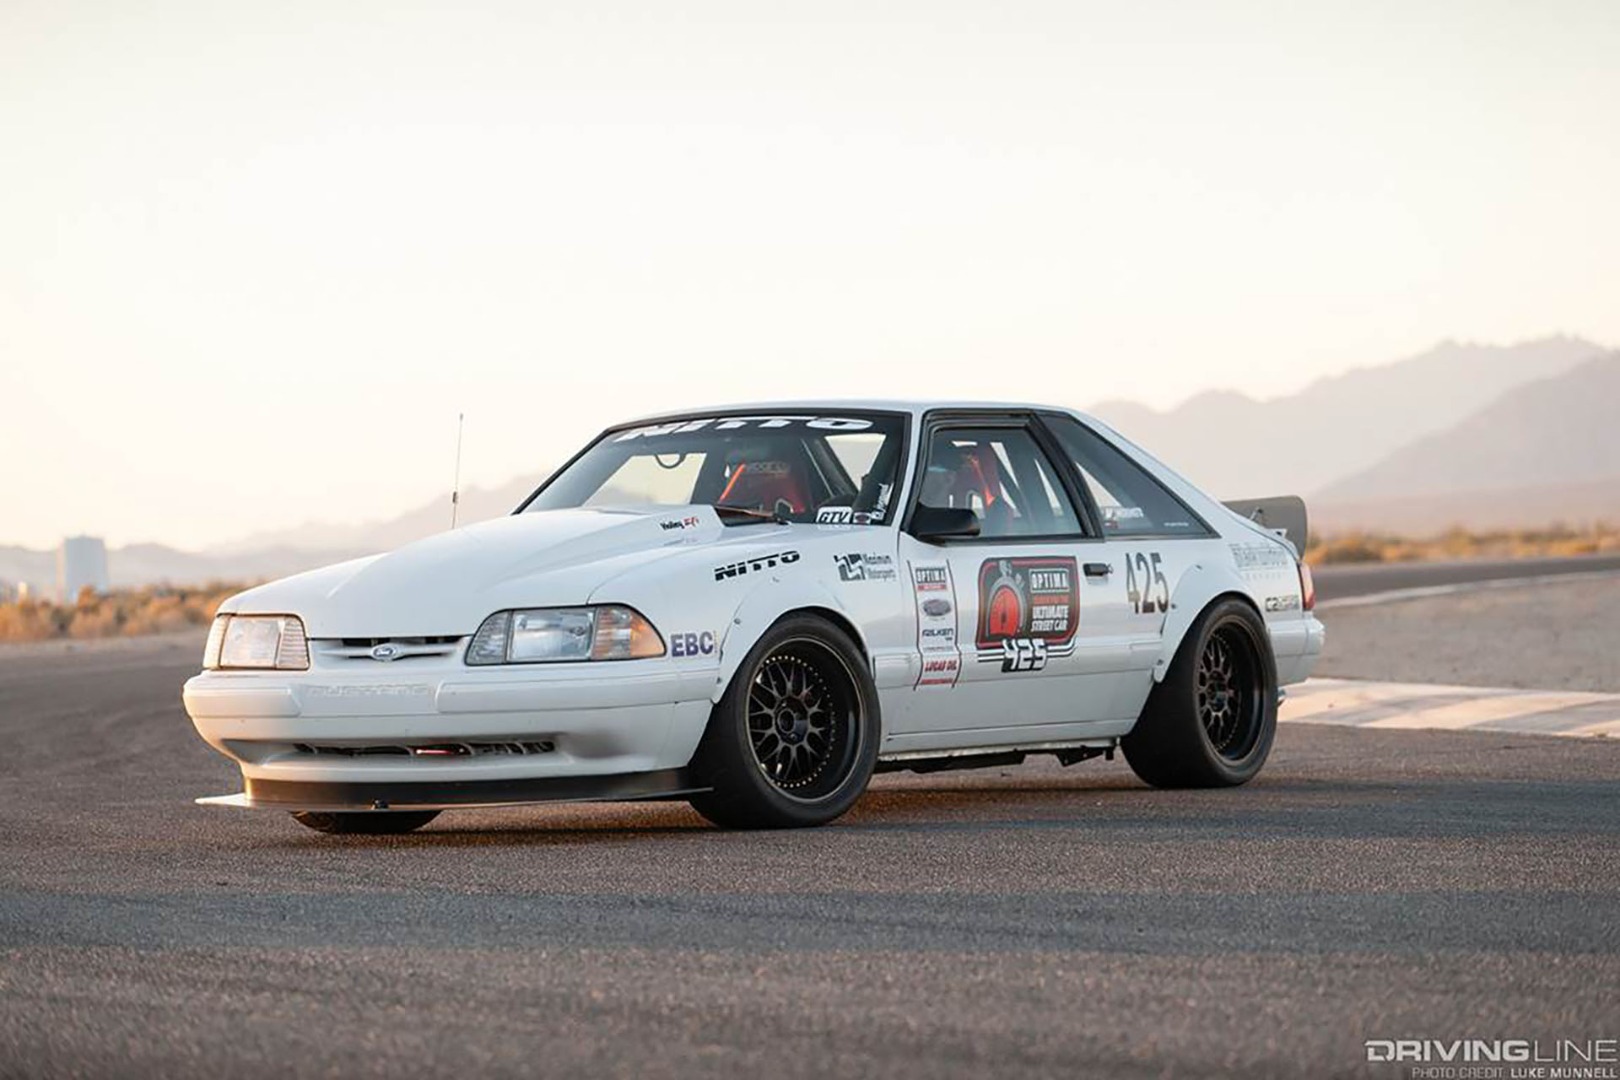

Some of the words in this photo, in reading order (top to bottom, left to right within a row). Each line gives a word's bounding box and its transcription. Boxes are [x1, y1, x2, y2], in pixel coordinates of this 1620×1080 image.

[613, 416, 873, 443] NITTO
[819, 511, 850, 524] GTV
[714, 550, 800, 581] NITTO
[916, 569, 946, 583] OPTIMA
[1031, 572, 1069, 589] OPTIMA
[1125, 552, 1169, 614] 425
[1054, 619, 1068, 631] CAR
[670, 631, 713, 657] EBC
[1001, 638, 1048, 672] 425
